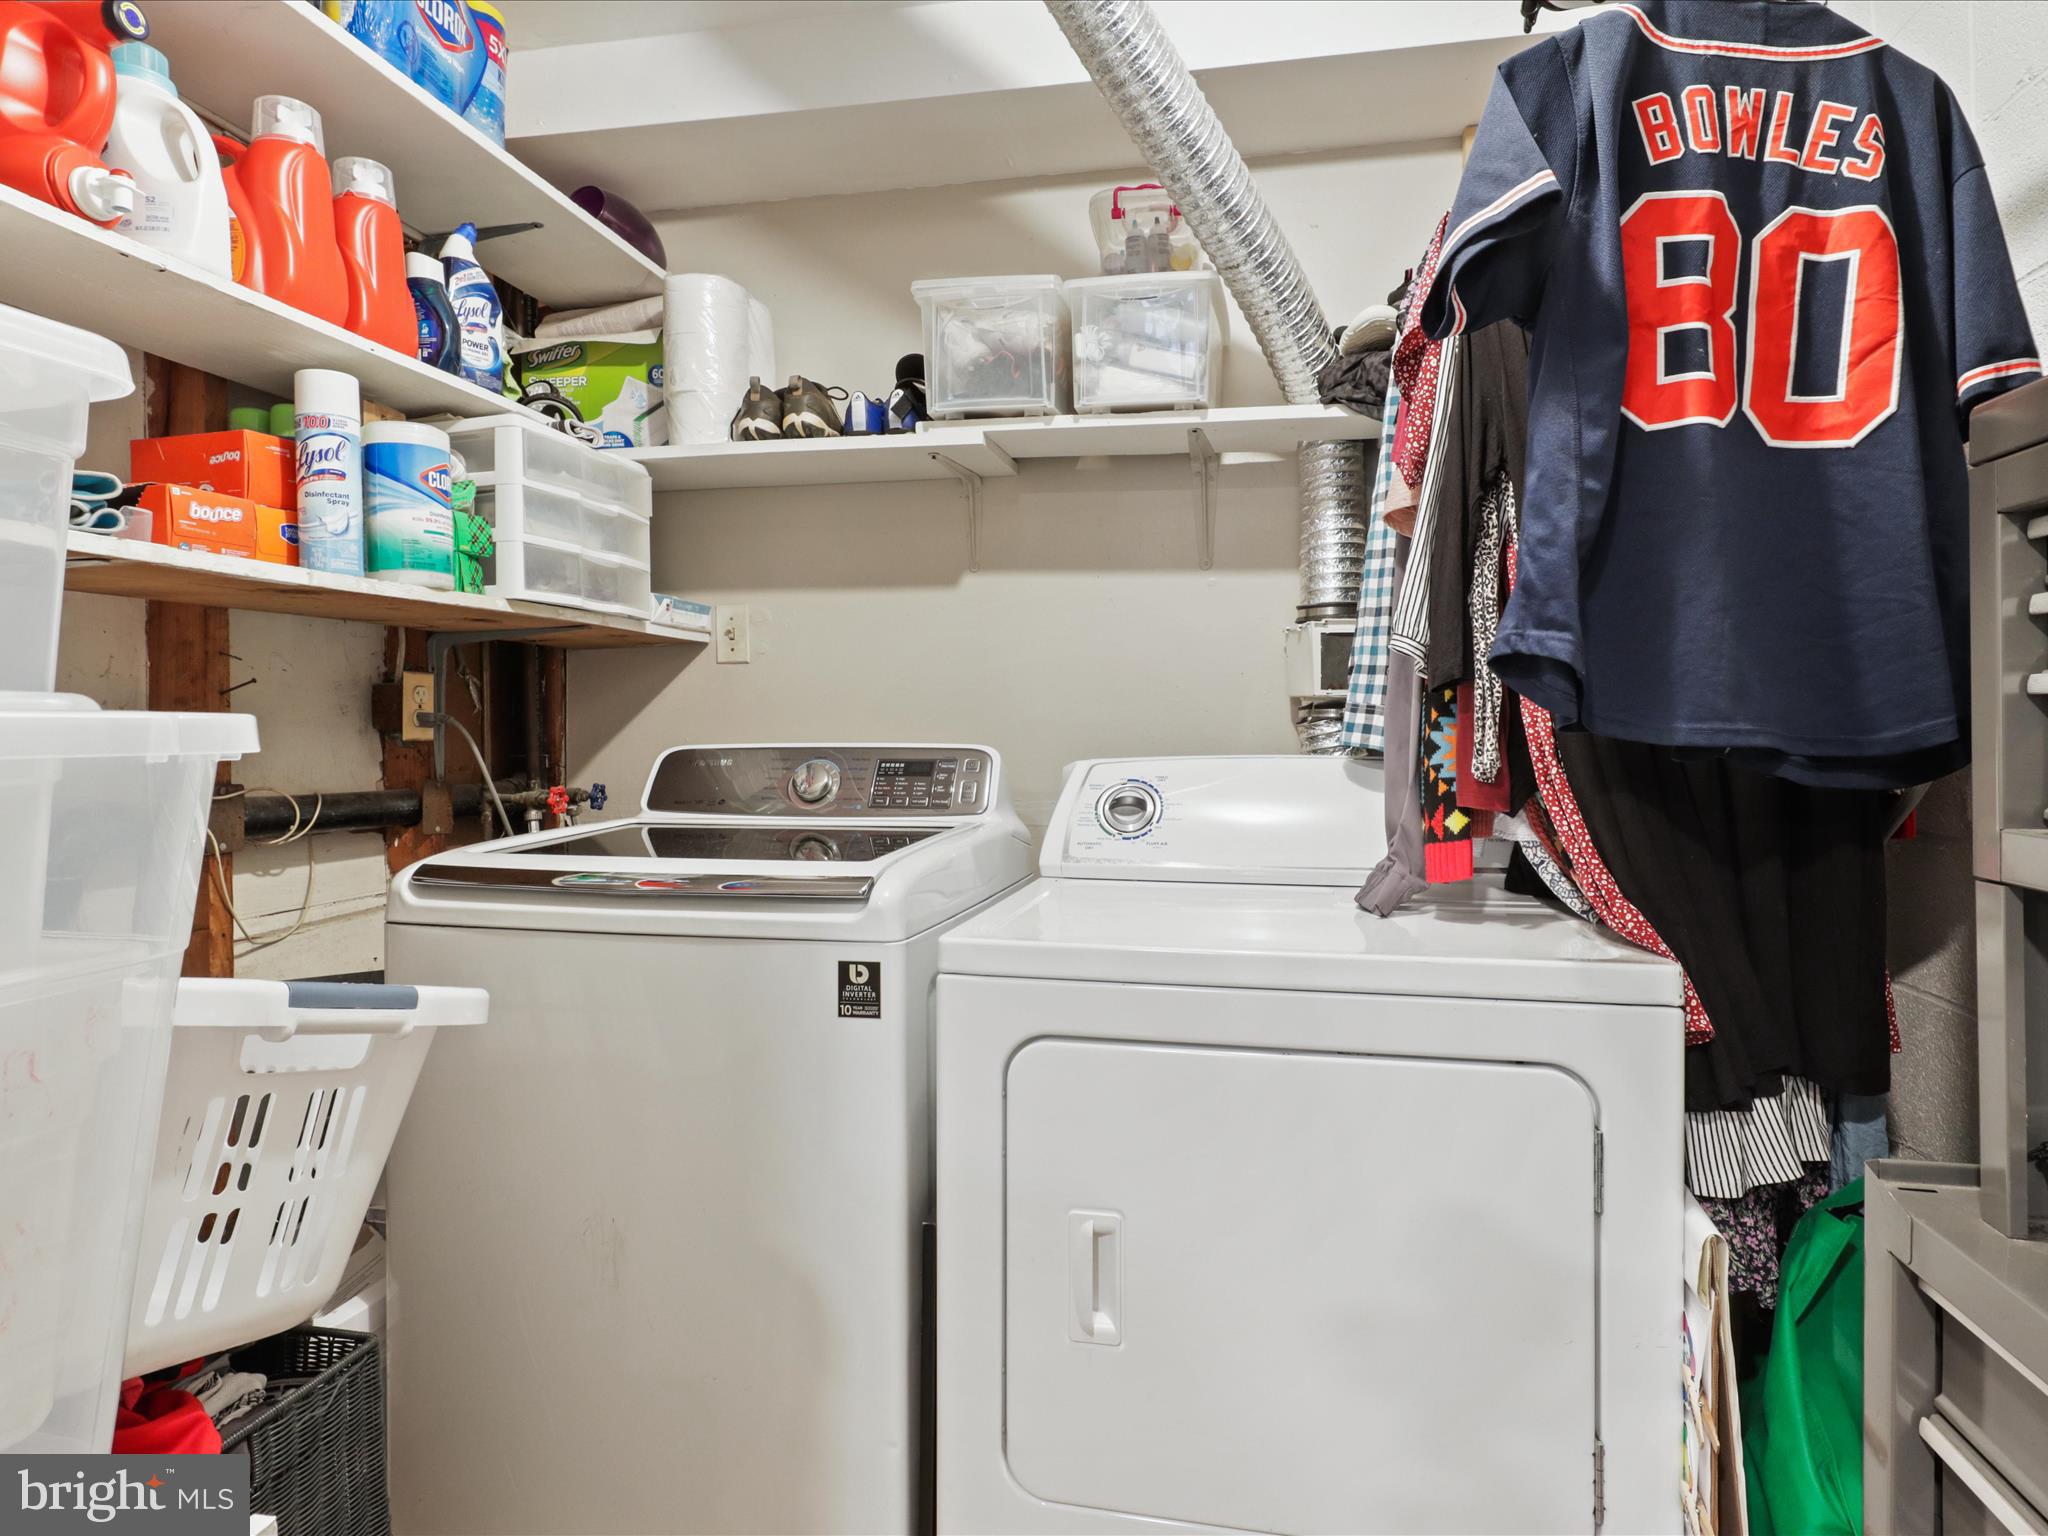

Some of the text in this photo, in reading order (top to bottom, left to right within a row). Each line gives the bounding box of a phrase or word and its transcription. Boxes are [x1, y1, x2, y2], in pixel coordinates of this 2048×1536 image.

[1632, 84, 1886, 182] BOWLES
[455, 298, 488, 323] Lysol
[1620, 189, 1905, 449] 80
[462, 338, 489, 351] POWER
[529, 344, 580, 368] Swiffer
[297, 440, 346, 477] Lysol
[304, 491, 350, 500] Disinfectant
[327, 498, 350, 507] Spray
[189, 500, 243, 522] bounce
[840, 1004, 852, 1016] 10
